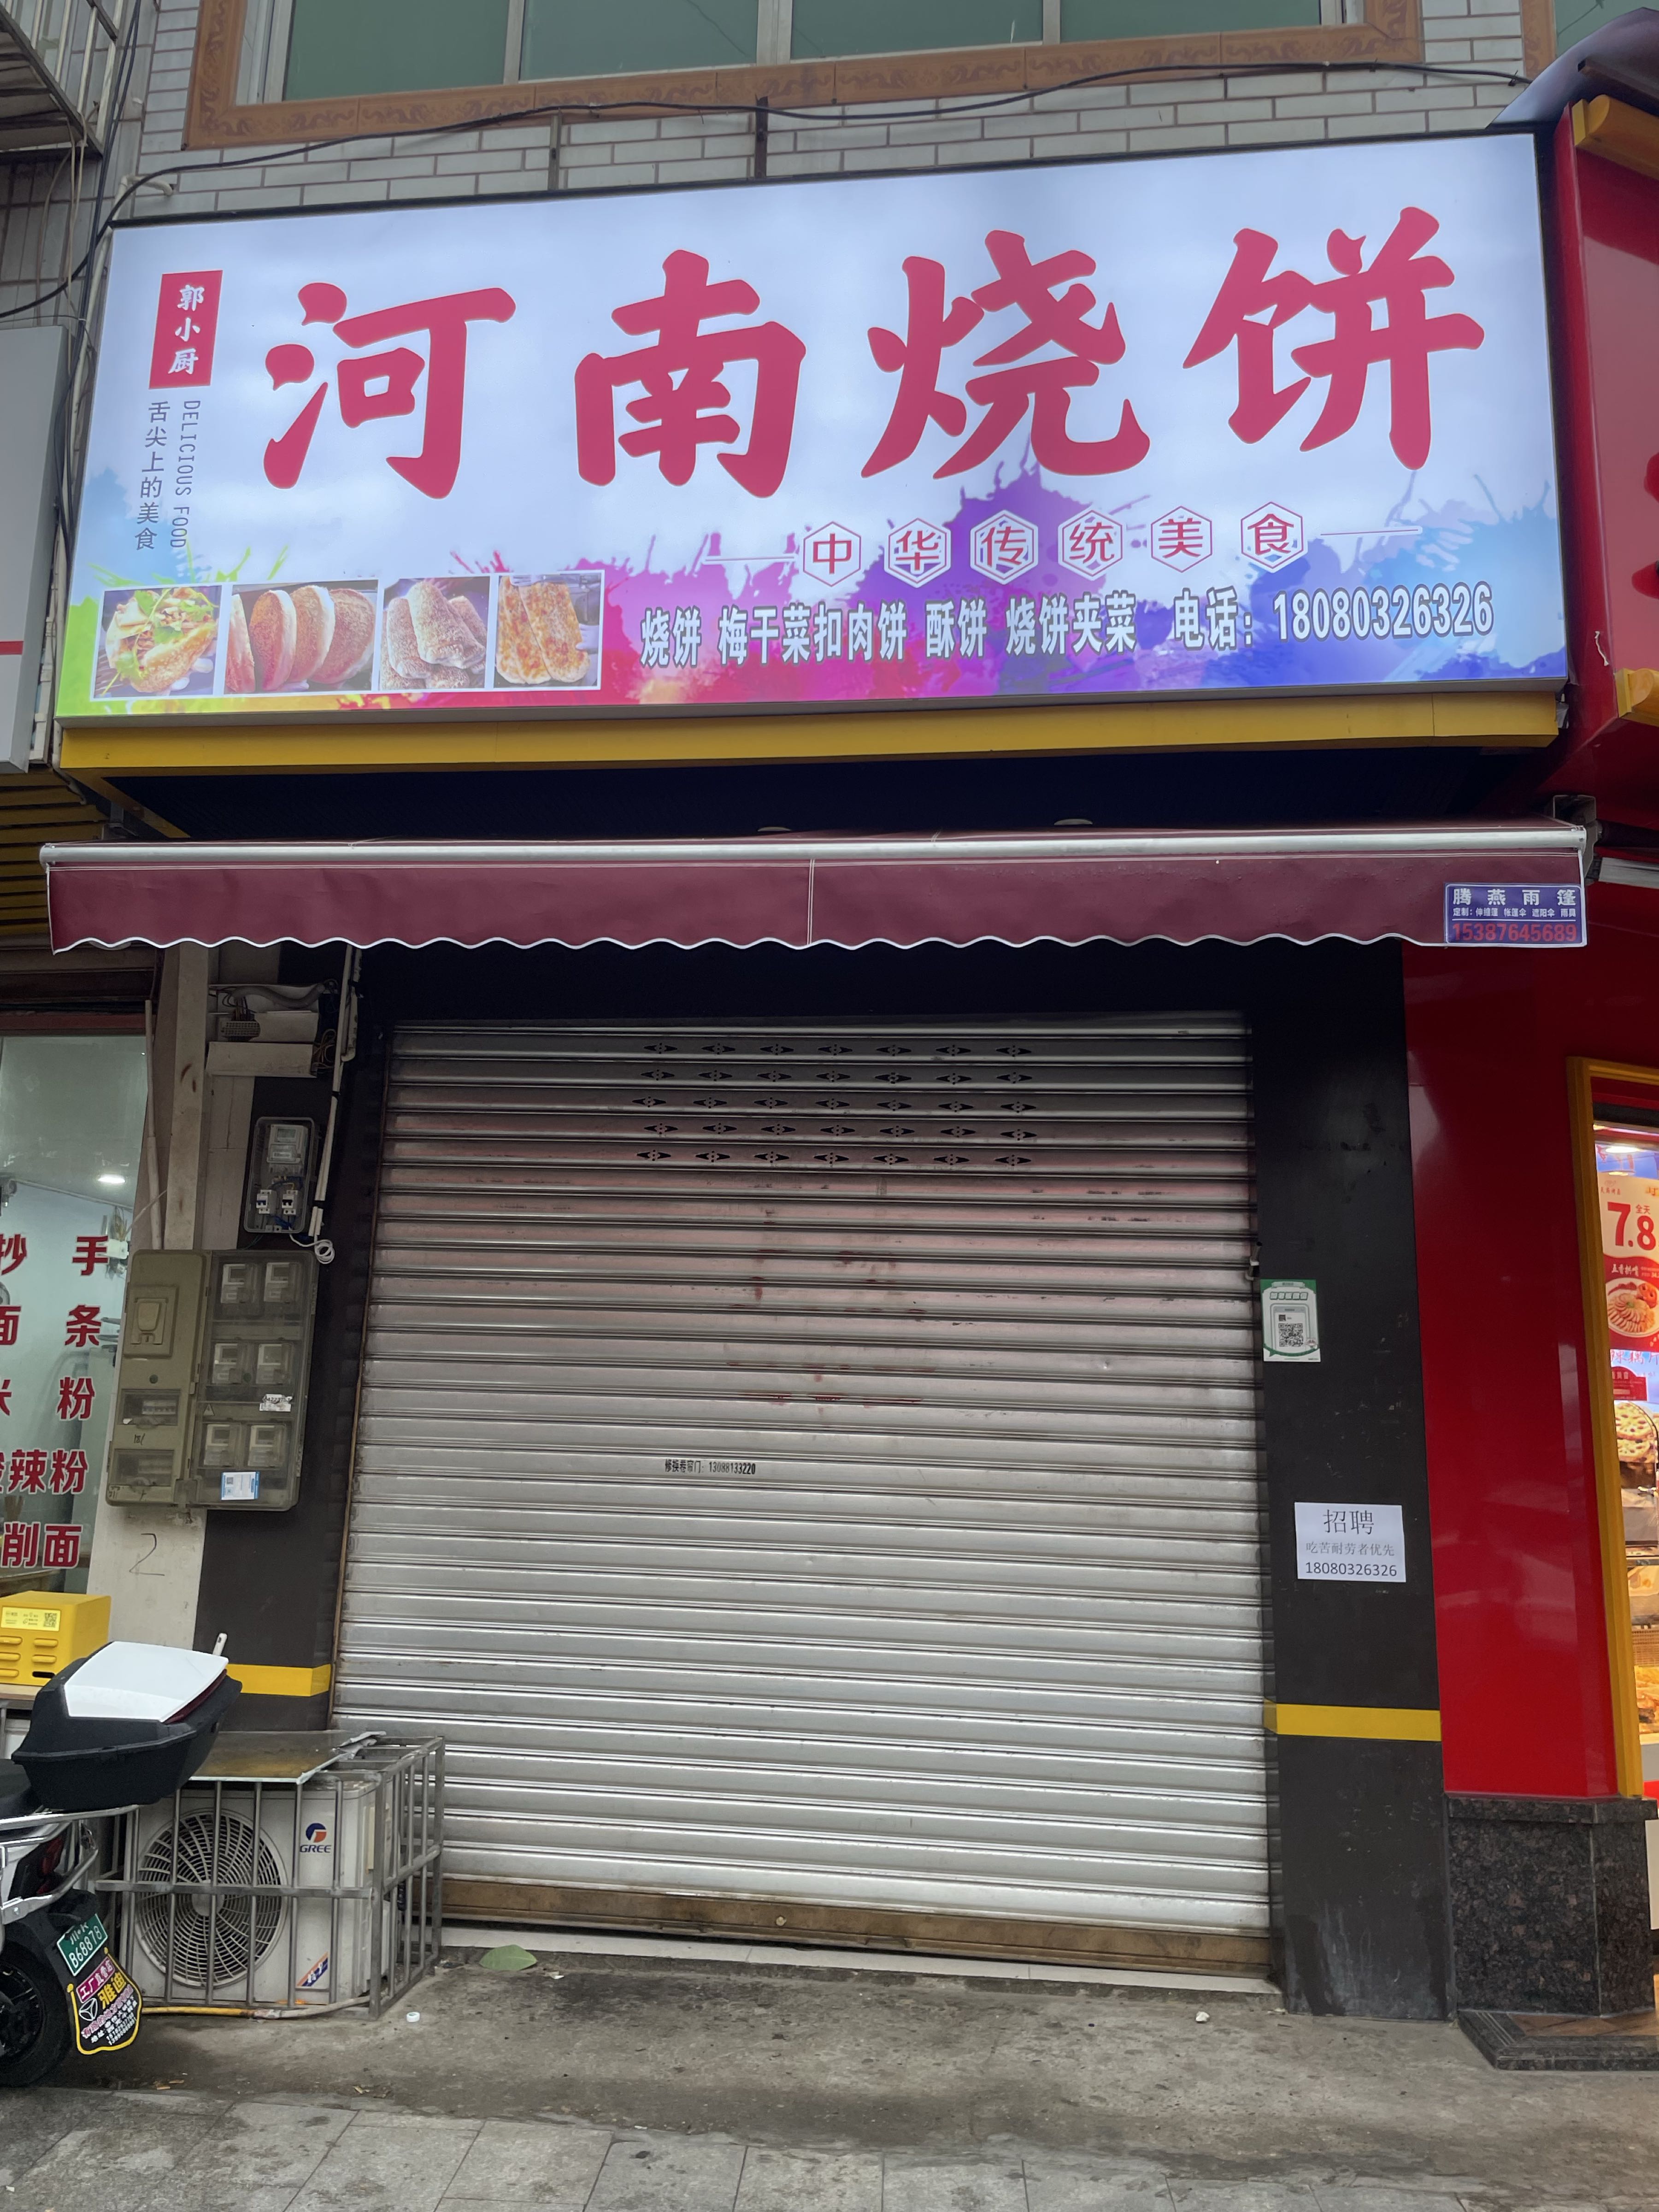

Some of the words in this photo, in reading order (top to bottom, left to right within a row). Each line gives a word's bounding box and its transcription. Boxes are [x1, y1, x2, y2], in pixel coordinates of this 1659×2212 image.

[168, 284, 205, 375] 郭小厨
[264, 208, 1484, 499] 河南烧饼
[175, 400, 201, 496] DELICIOUS
[135, 401, 171, 551] 舌尖上的美食
[170, 507, 190, 548] FOOD
[812, 513, 1294, 574] 中华传统美食
[641, 607, 701, 666] 烧饼
[719, 601, 907, 665] 梅干菜扣肉饼
[926, 598, 987, 658] 酥饼
[1006, 590, 1136, 656] 烧饼夹菜
[1273, 582, 1494, 641] 18080326326
[1453, 923, 1577, 942] 15387645689
[1607, 1201, 1656, 1251] 7.8
[1635, 1204, 1651, 1214] 全天
[0, 1449, 88, 1493] 辣粉
[1323, 1509, 1374, 1535] 招聘
[1306, 1541, 1394, 1556] 吃苦耐劳者优先
[1306, 1562, 1397, 1577] 18080326326
[300, 1844, 331, 1853] GREE
[98, 1972, 126, 2010] 雅迪
